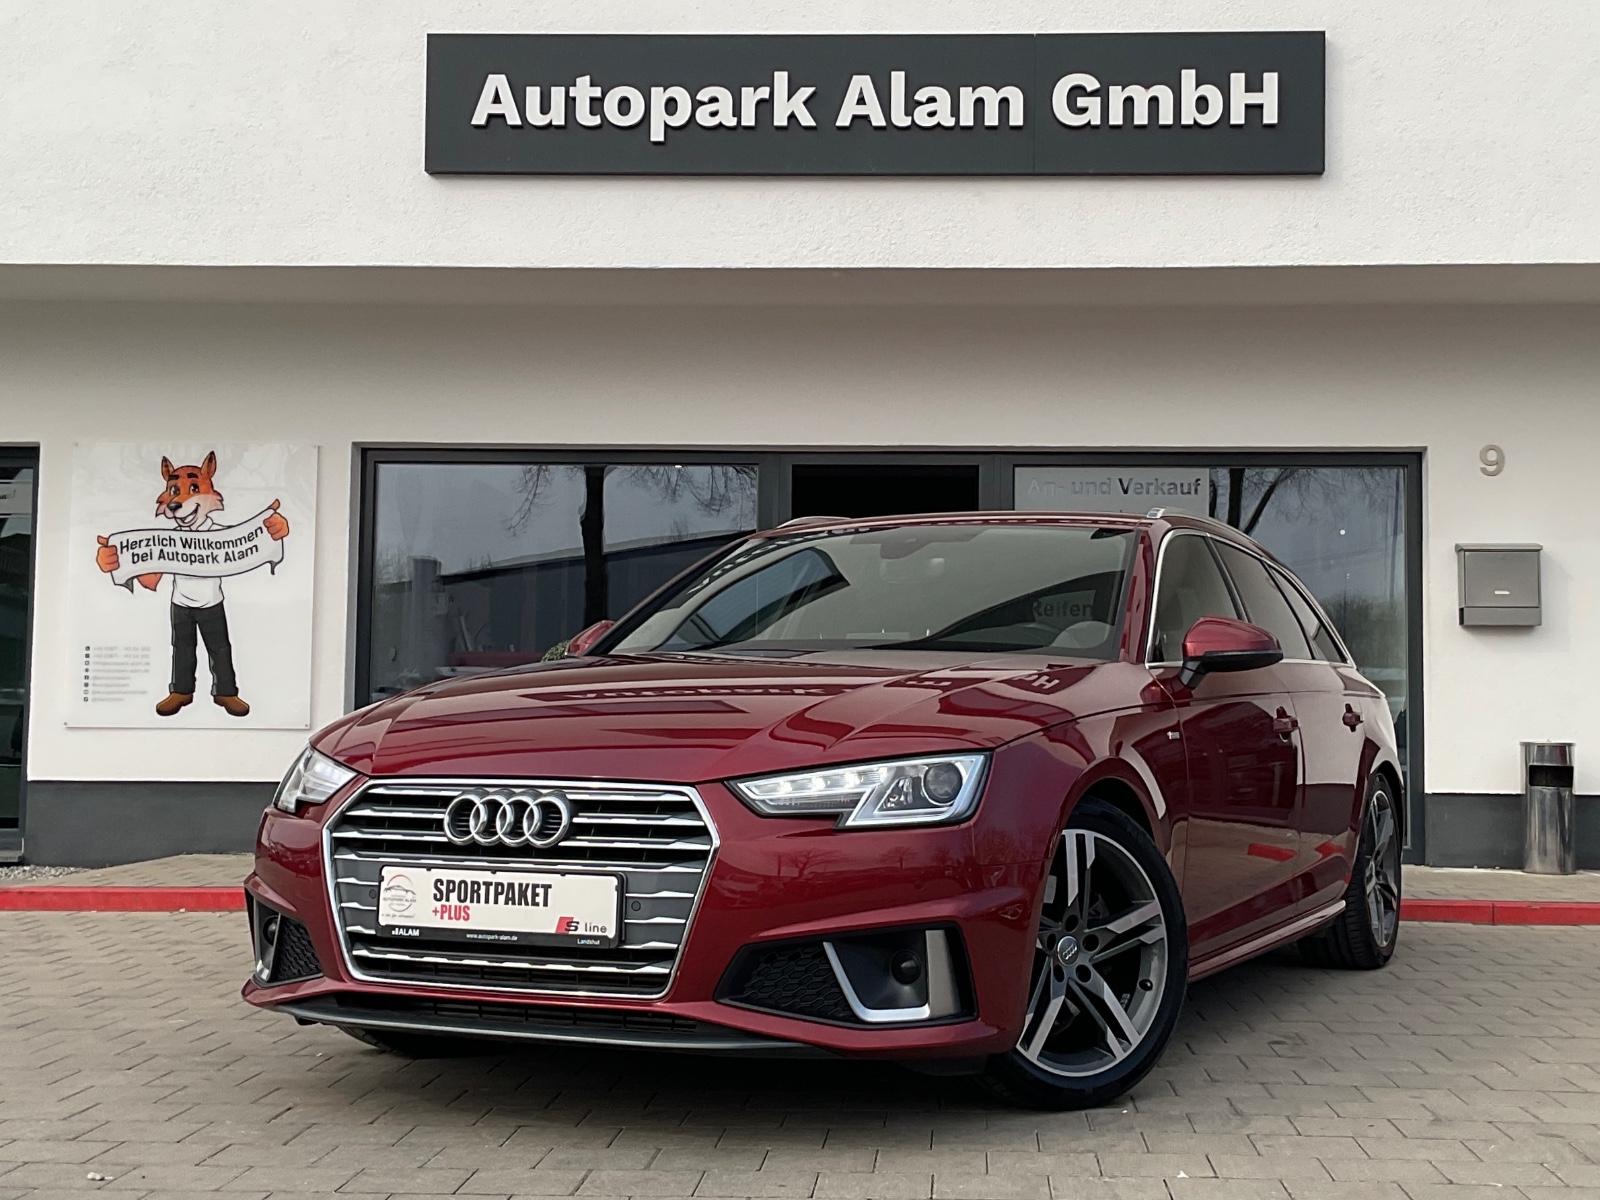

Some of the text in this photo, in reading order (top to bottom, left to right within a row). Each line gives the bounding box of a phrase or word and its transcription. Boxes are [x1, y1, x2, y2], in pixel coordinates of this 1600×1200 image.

[470, 70, 1281, 144] Autopark Alam GmbH
[1479, 444, 1506, 477] 9
[1072, 478, 1111, 495] und
[1118, 477, 1201, 495] Verkauf
[120, 526, 264, 554] Herzlich Willkommen
[131, 544, 259, 565] bei Autopark Alam
[433, 878, 552, 907] SPORTPAKET
[432, 904, 470, 921] +PLUS
[564, 920, 608, 933] S line
